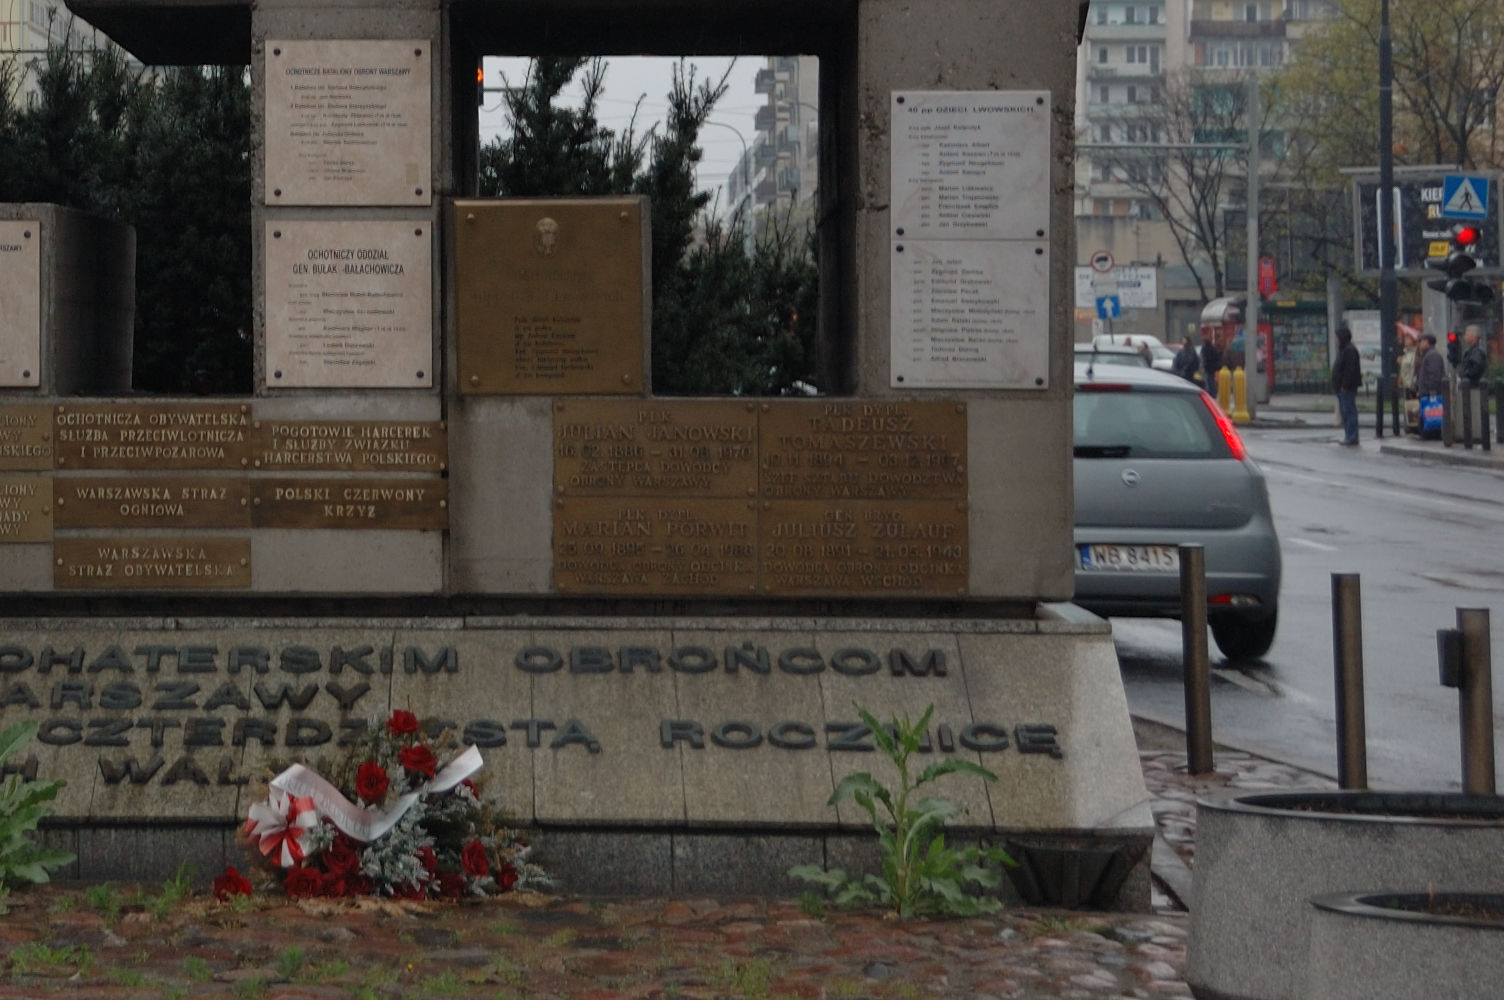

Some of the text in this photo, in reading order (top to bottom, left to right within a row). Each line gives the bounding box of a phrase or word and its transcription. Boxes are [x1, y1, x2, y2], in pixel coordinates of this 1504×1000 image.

[308, 249, 389, 260] OCHOTNICZY ODDZIAŁ
[57, 413, 247, 425] OCHOTNICZA OBYWATELSKA
[809, 417, 913, 432] TADEUSZ
[120, 430, 244, 442] PRZECIWLOTNICZA
[272, 425, 431, 438] POGOTOWIE HARCEREK
[558, 425, 753, 441] JULIAN JANOWSKI
[273, 439, 277, 449] I
[777, 434, 948, 450] TOMASZEWSKI
[81, 446, 85, 457] I
[263, 452, 436, 465] HARCERSTWA POLSKIEGO
[76, 487, 171, 499] WARSZAWSKA
[275, 488, 425, 501] POLSKI CZERWONY
[120, 504, 184, 516] OGNIOWA
[562, 521, 748, 537] MARIAN PORWIT
[97, 548, 207, 560] WARSZAWSKA
[1094, 547, 1120, 563] WB
[124, 564, 233, 576] OBYWATELSKA
[515, 642, 947, 677] OBROŃCOM
